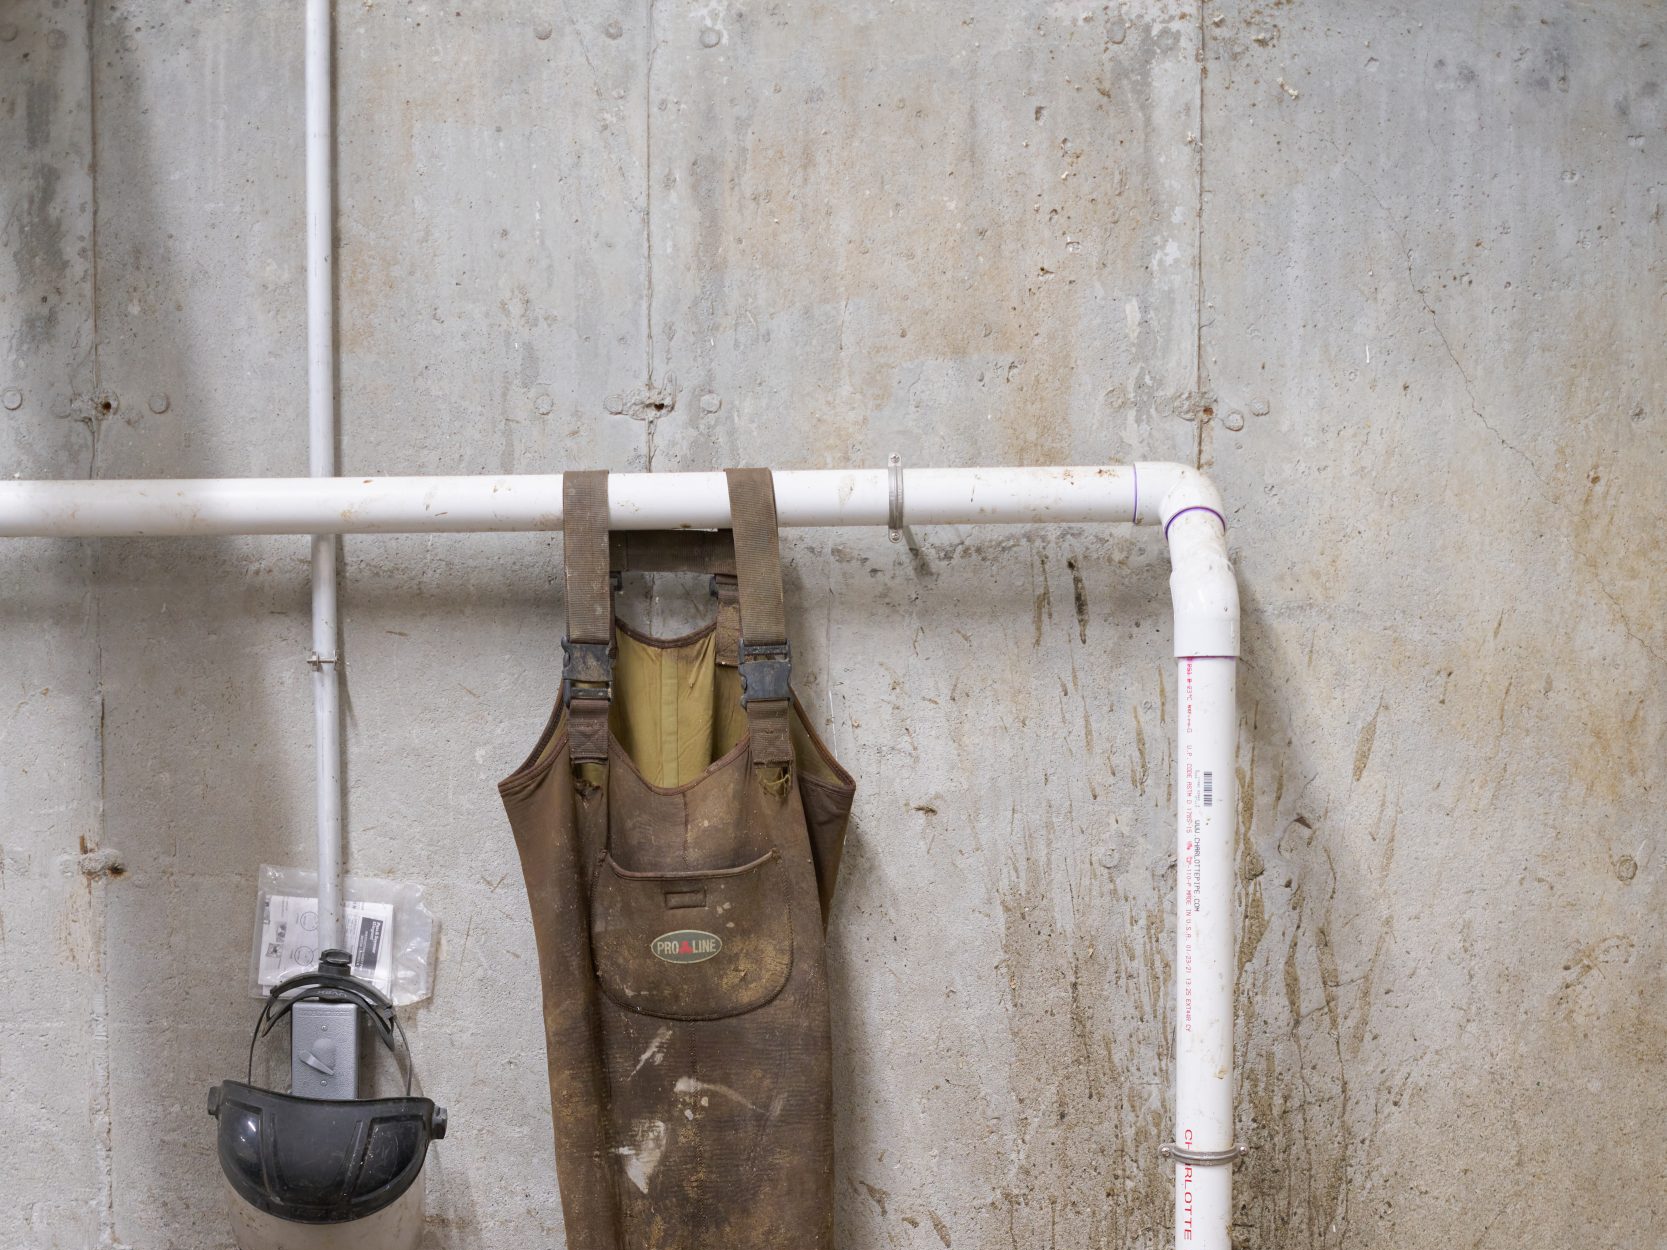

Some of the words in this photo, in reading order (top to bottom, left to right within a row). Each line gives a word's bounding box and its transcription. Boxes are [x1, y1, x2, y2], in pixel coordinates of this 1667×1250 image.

[1186, 909, 1192, 917] IN
[657, 941, 679, 954] PRO
[693, 939, 716, 953] LINE
[1184, 1129, 1192, 1240] CHRLOTTE
